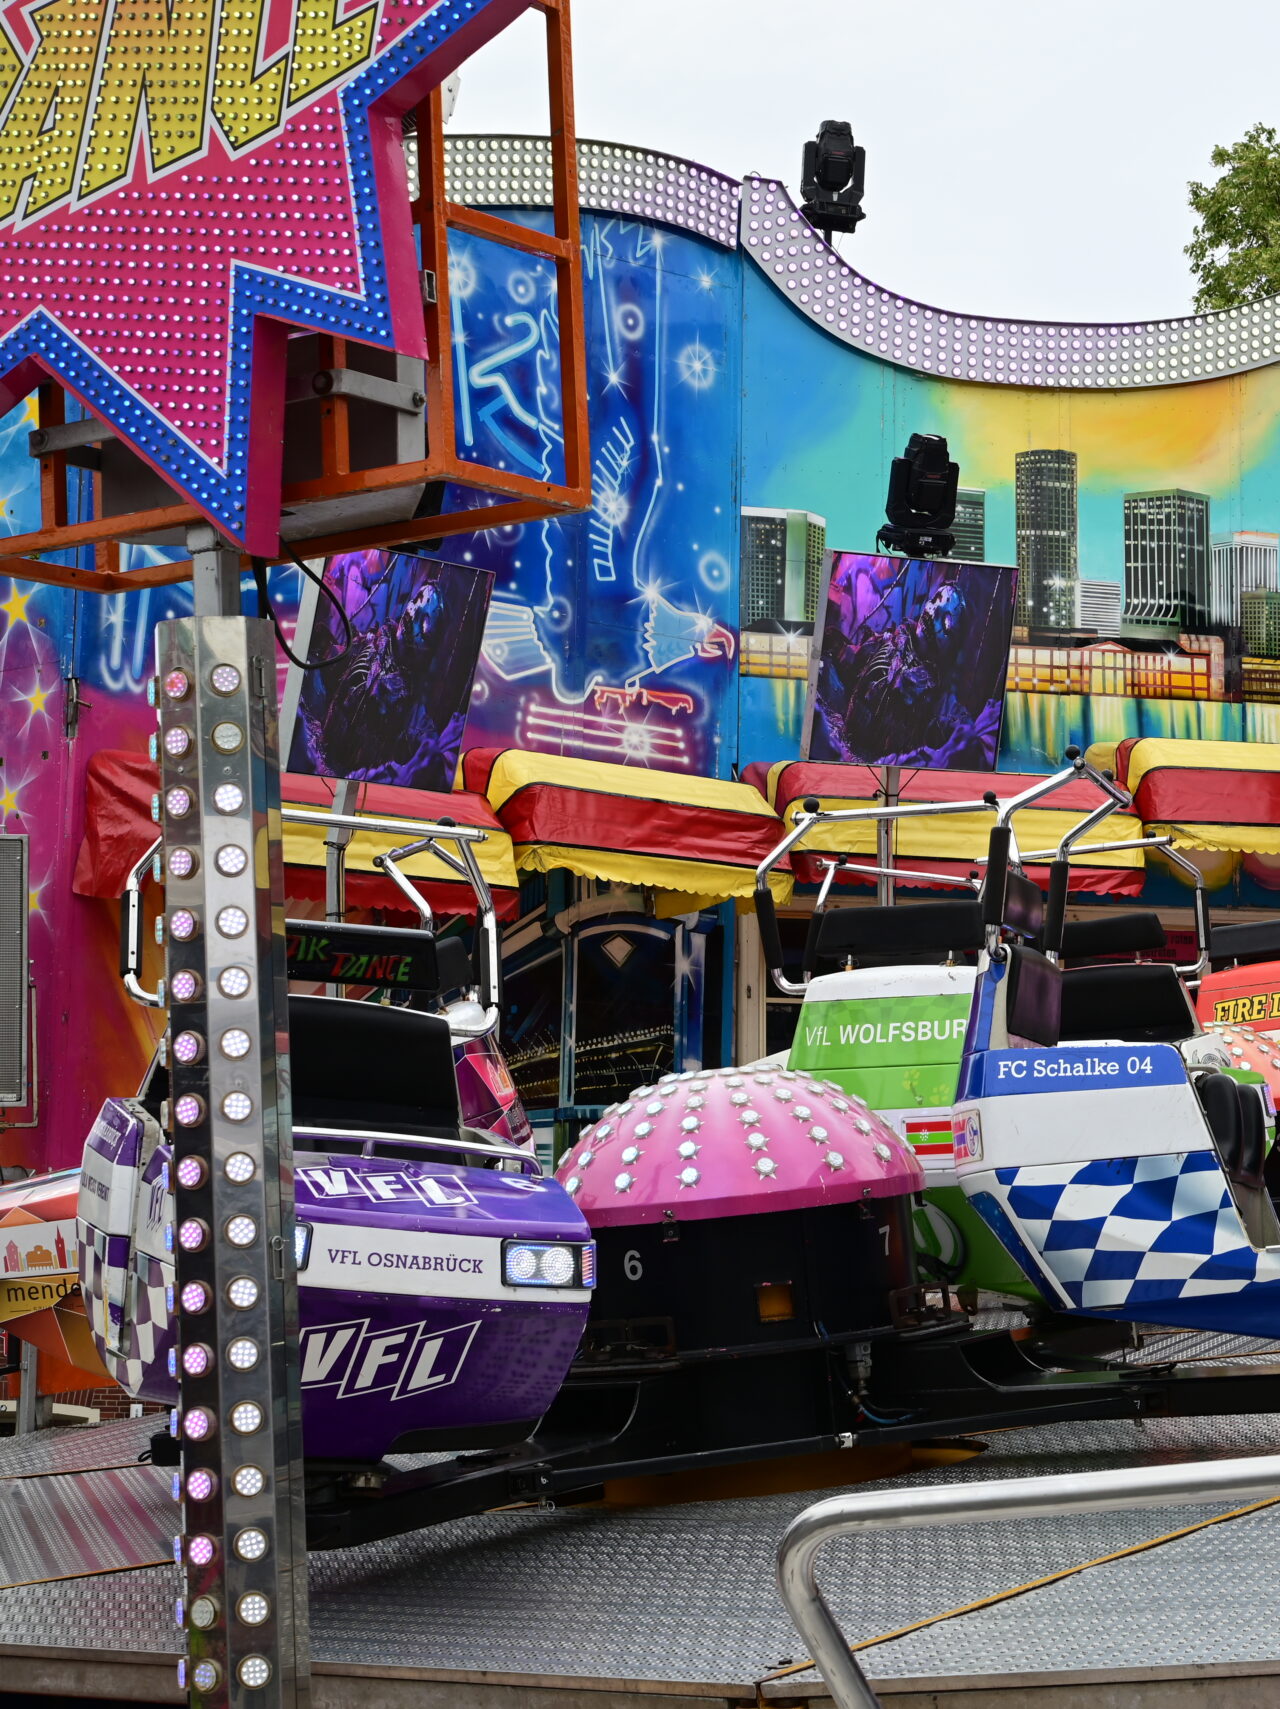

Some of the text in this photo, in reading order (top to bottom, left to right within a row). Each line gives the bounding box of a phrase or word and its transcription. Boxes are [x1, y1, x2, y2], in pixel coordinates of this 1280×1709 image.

[331, 952, 413, 982] DANCE
[1215, 994, 1268, 1024] FIRE
[806, 1018, 968, 1047] VfL WOLFSBUR
[998, 1056, 1153, 1079] FC Schalke 04
[301, 1166, 469, 1206] VFL
[502, 1177, 549, 1192] 6
[878, 1224, 890, 1256] 7
[328, 1248, 483, 1274] VFL OSNABRÜCK
[623, 1249, 643, 1281] 6
[7, 1279, 80, 1303] mende
[301, 1327, 447, 1391] VFL
